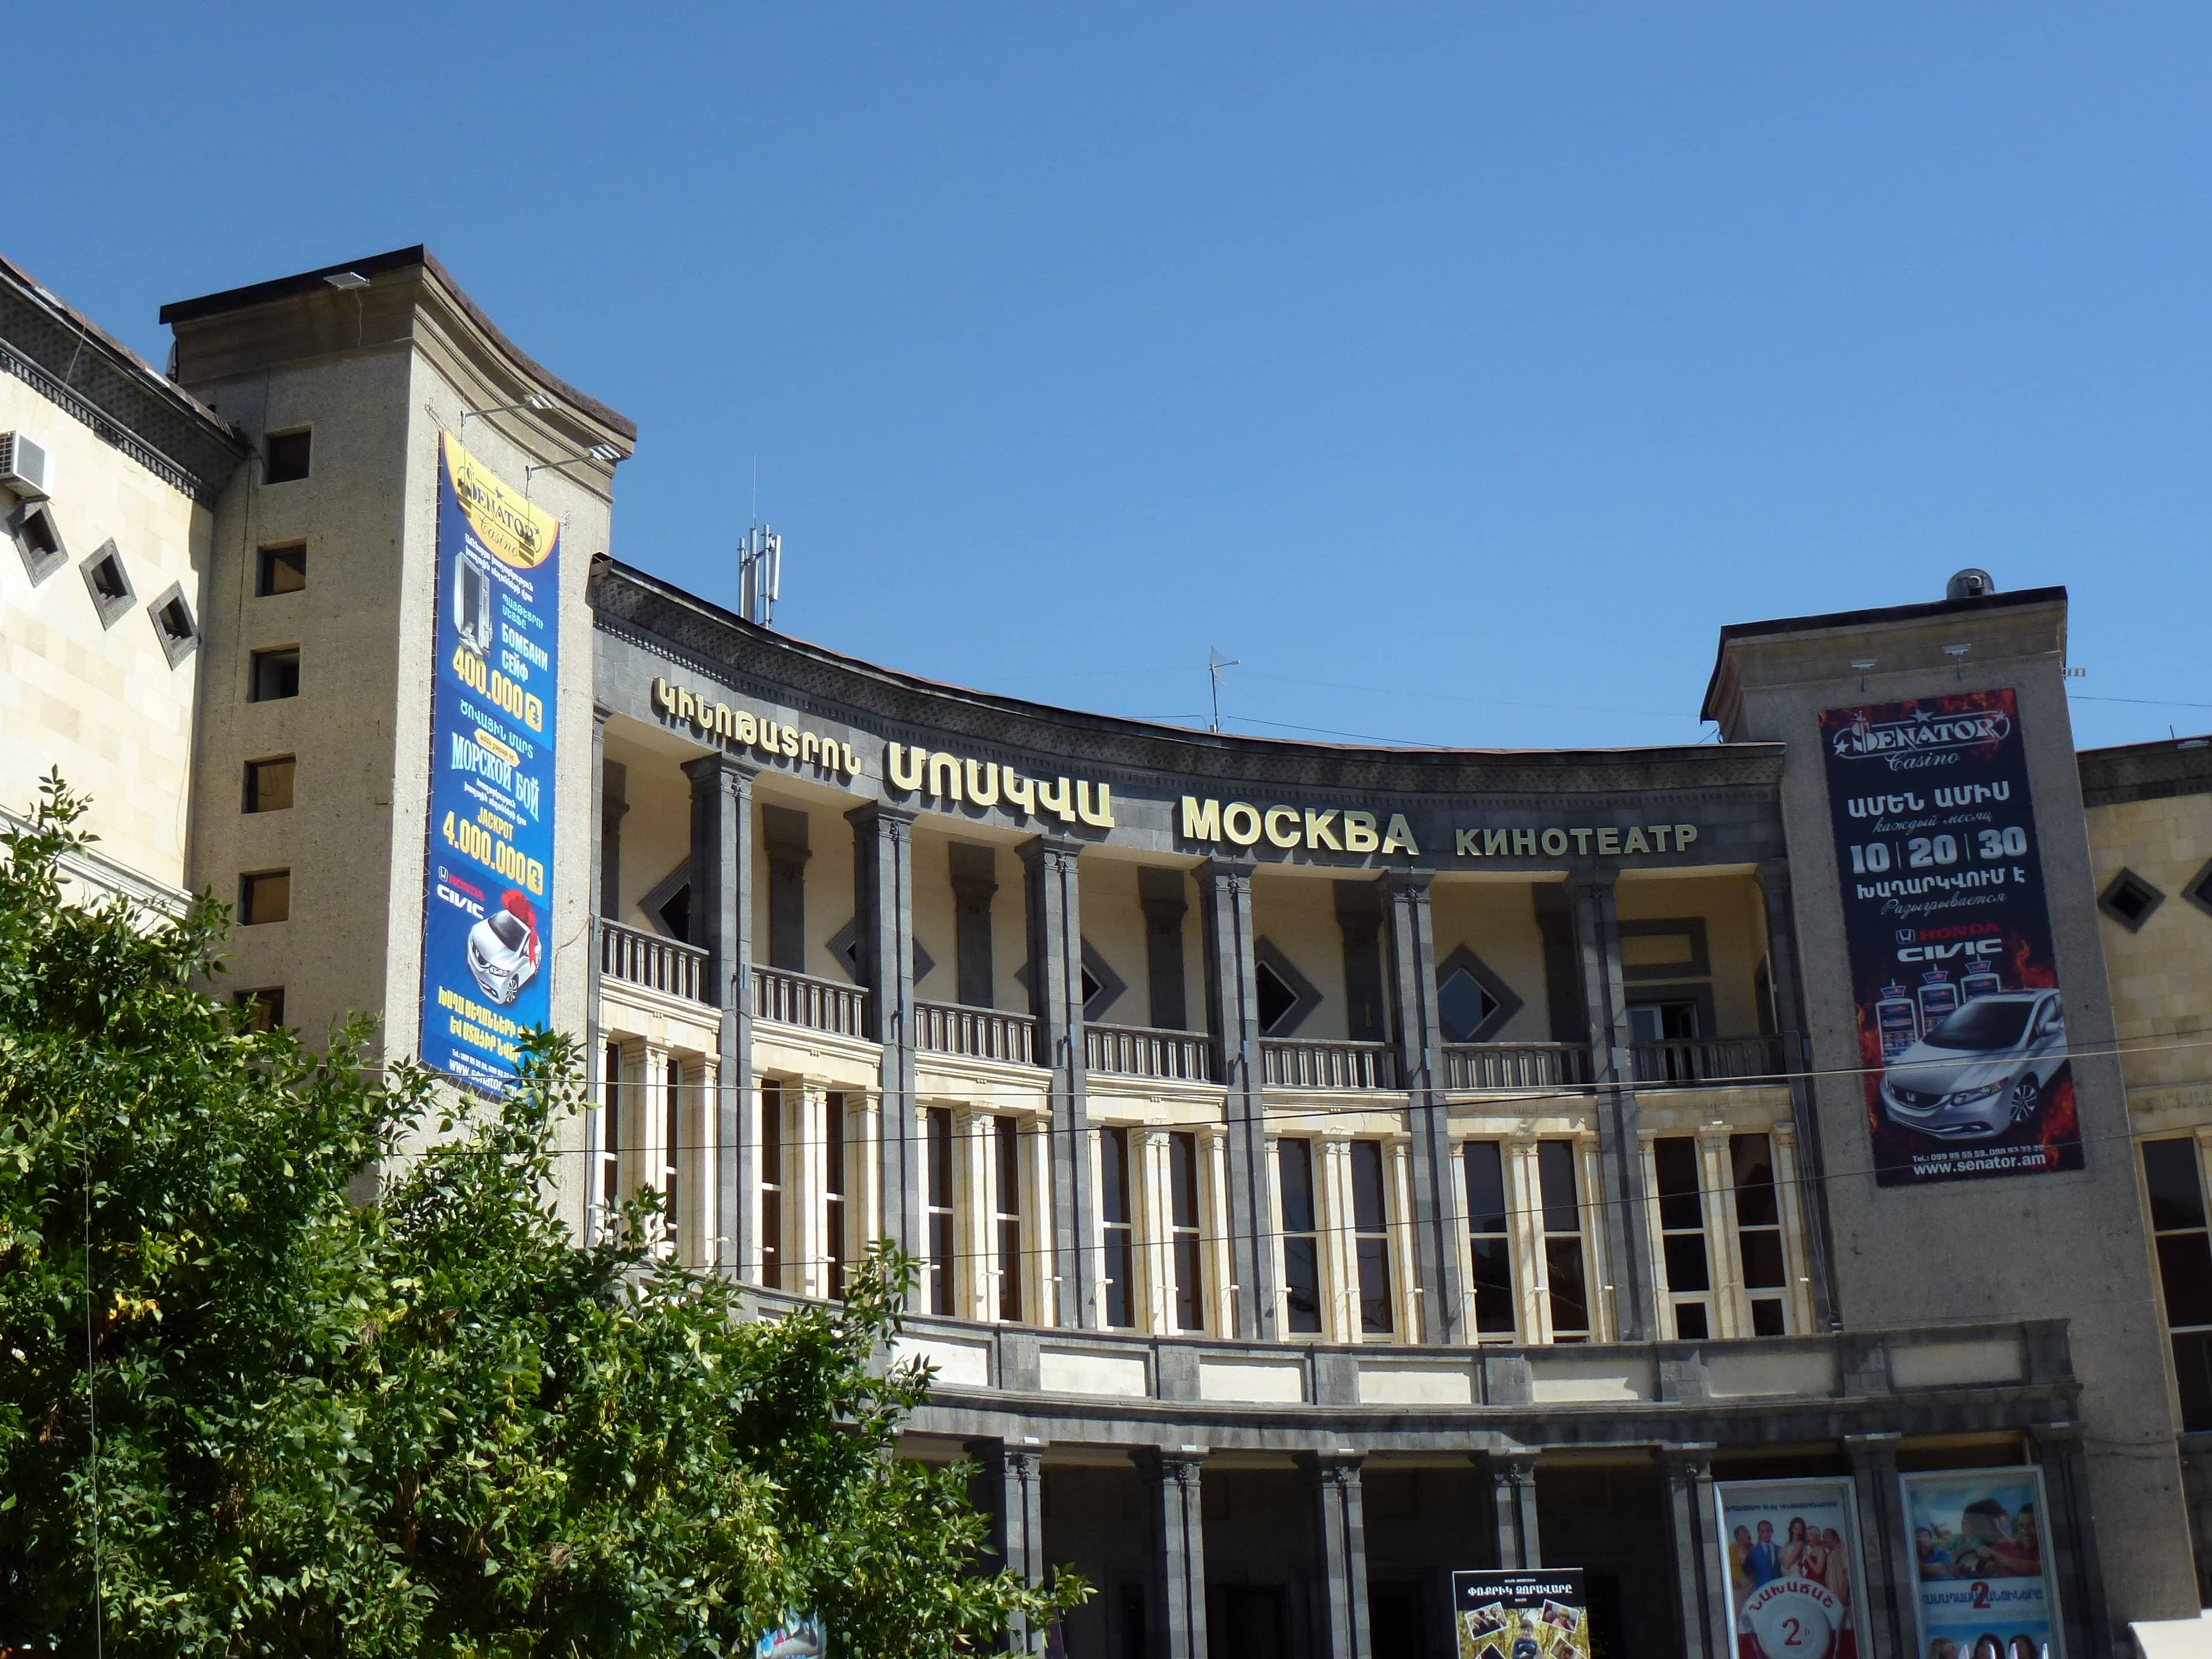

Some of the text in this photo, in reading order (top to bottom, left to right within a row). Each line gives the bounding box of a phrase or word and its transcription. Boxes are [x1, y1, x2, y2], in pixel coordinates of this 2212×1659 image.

[479, 514, 519, 557] Casino
[502, 623, 548, 672] БОМБАНИ
[502, 650, 529, 681] СЕЙФ
[509, 731, 533, 759] ՄԱՐՏ
[1850, 717, 1998, 753] SENATOR
[652, 677, 1115, 830] ԿԻՆՈԹԱՏՐՈՆ ՄՈՍԿՎԱ
[1885, 751, 1960, 772] Casino
[452, 732, 539, 823] МОРСКОЙ БОЙ
[1847, 781, 2010, 818] ԱՄԵՆ ԱՄԻՍ
[478, 806, 513, 842] JACKPOT
[1180, 794, 1698, 857] МОСКВА КИНОТЕАТР
[1850, 827, 2028, 874] 10 20 30
[1857, 866, 2026, 900] ԽԱՂԱՐԿՎՈՒՄ Է
[437, 884, 484, 920] CIVIC
[1919, 922, 2001, 941] HONDA
[1897, 938, 2003, 962] CIVIC
[449, 1059, 517, 1097] www.senator.m
[1913, 1153, 2047, 1176] www.senator.am
[1971, 1581, 1991, 1608] 2
